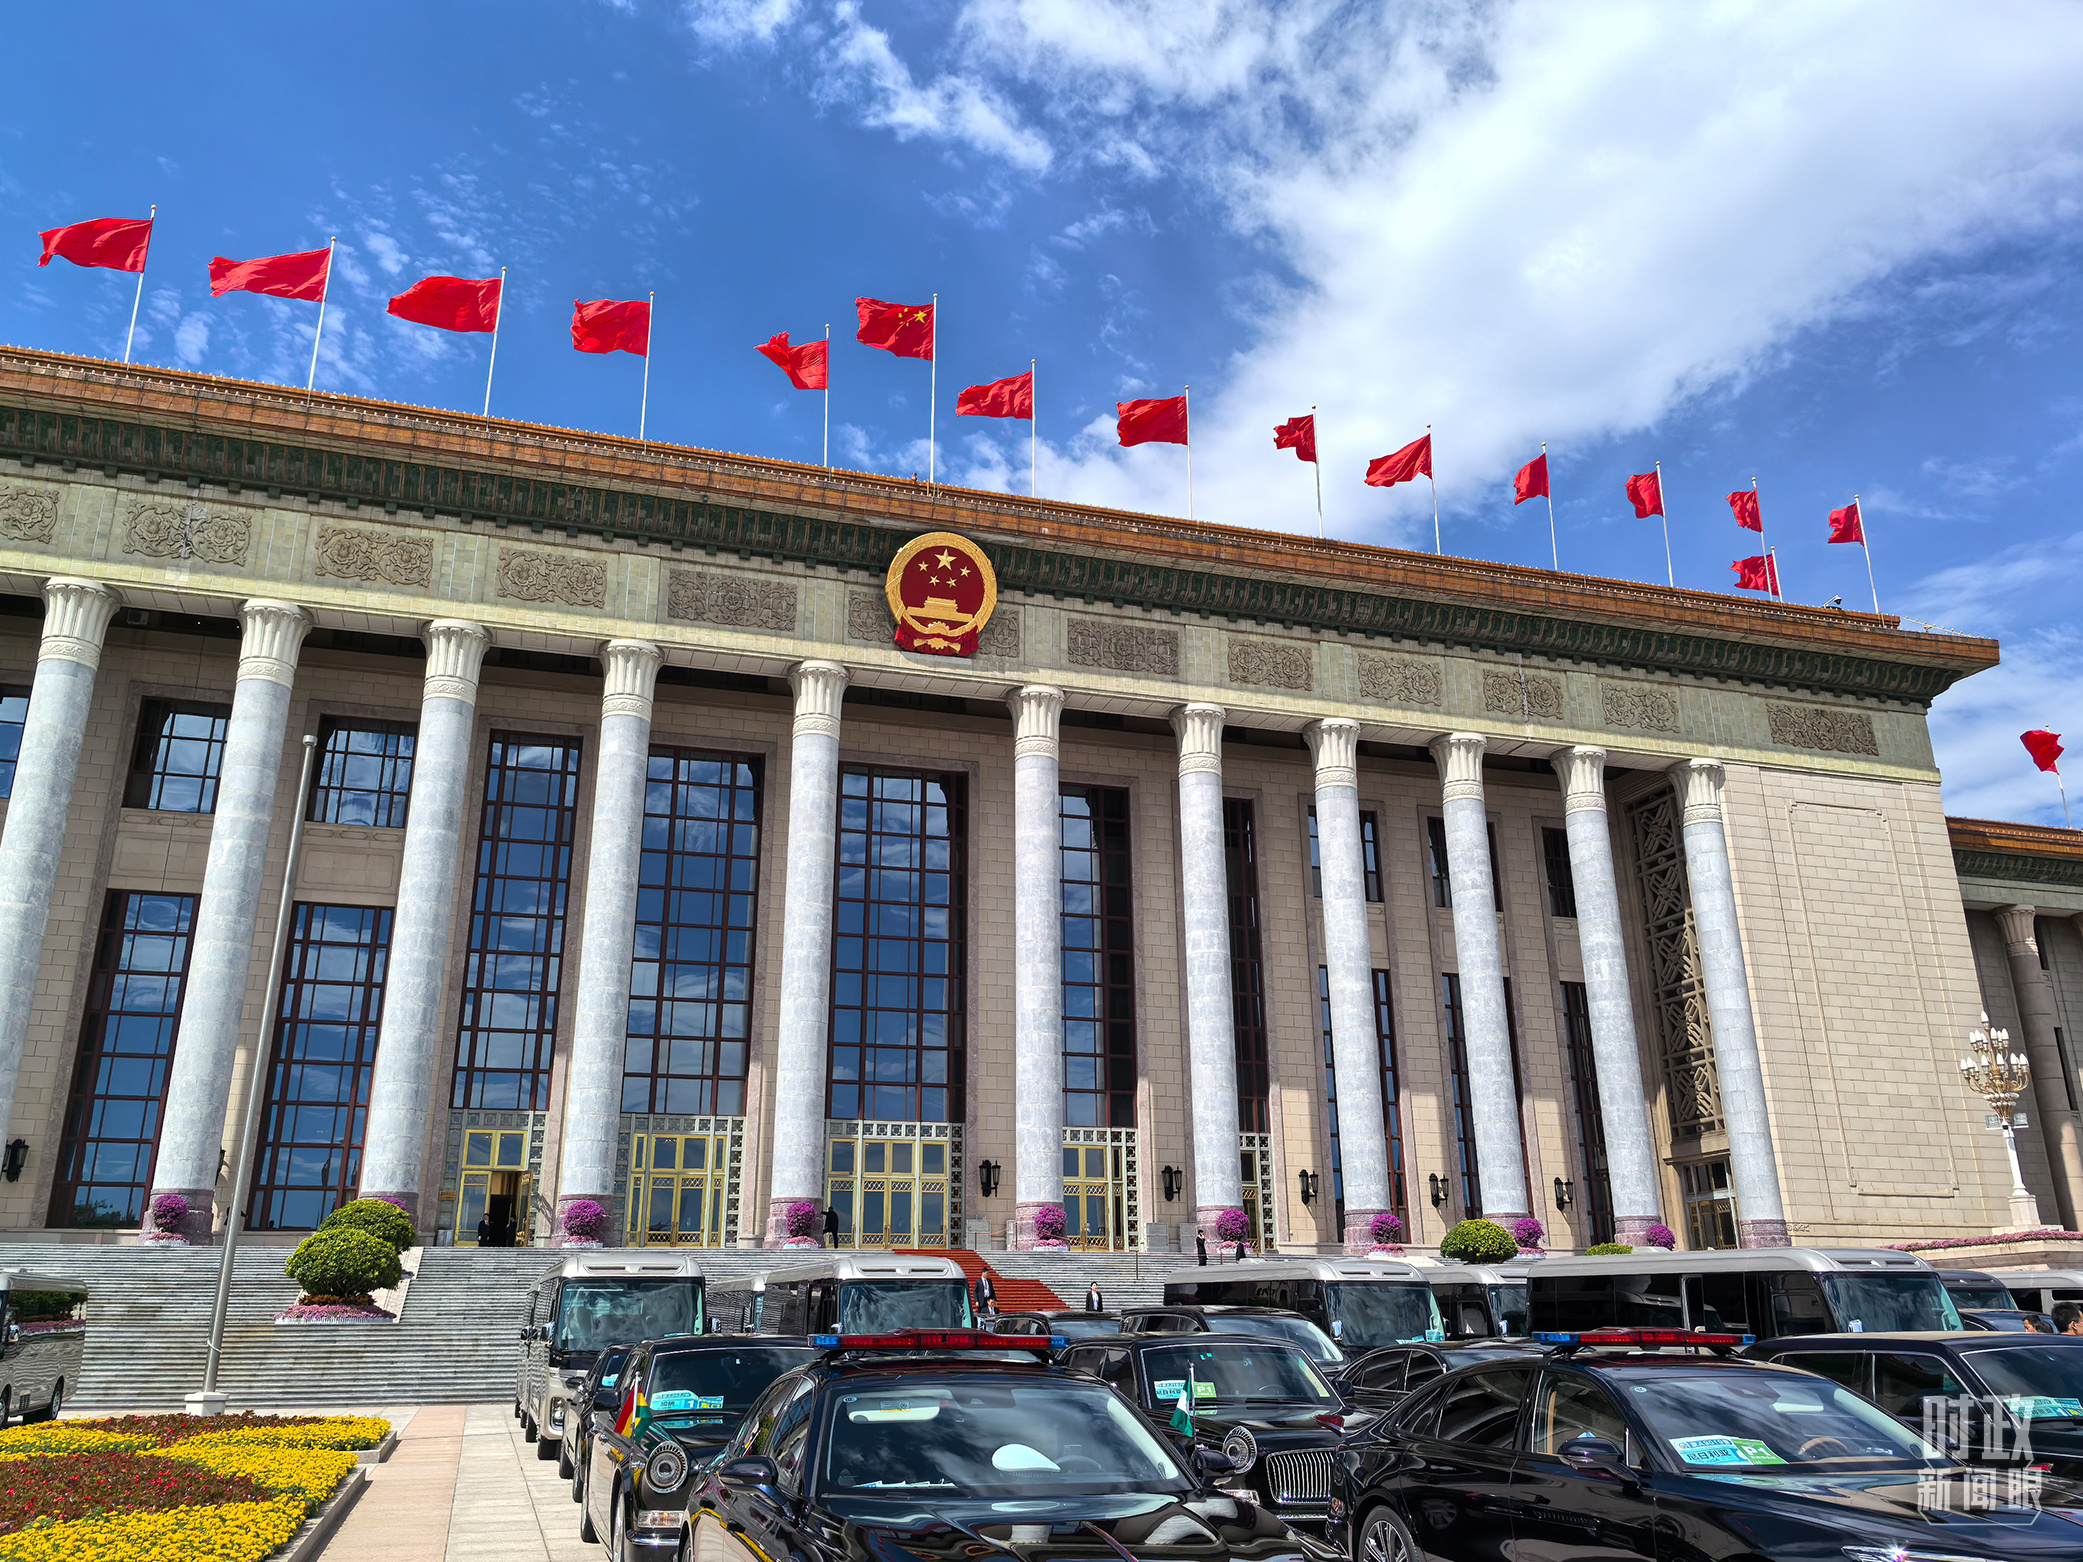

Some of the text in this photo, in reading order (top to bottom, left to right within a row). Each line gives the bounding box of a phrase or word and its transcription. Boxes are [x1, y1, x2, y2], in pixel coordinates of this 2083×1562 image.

[688, 1400, 694, 1408] 1
[1687, 1448, 1731, 1460] 尼日利亚
[1741, 1445, 1771, 1456] P1
